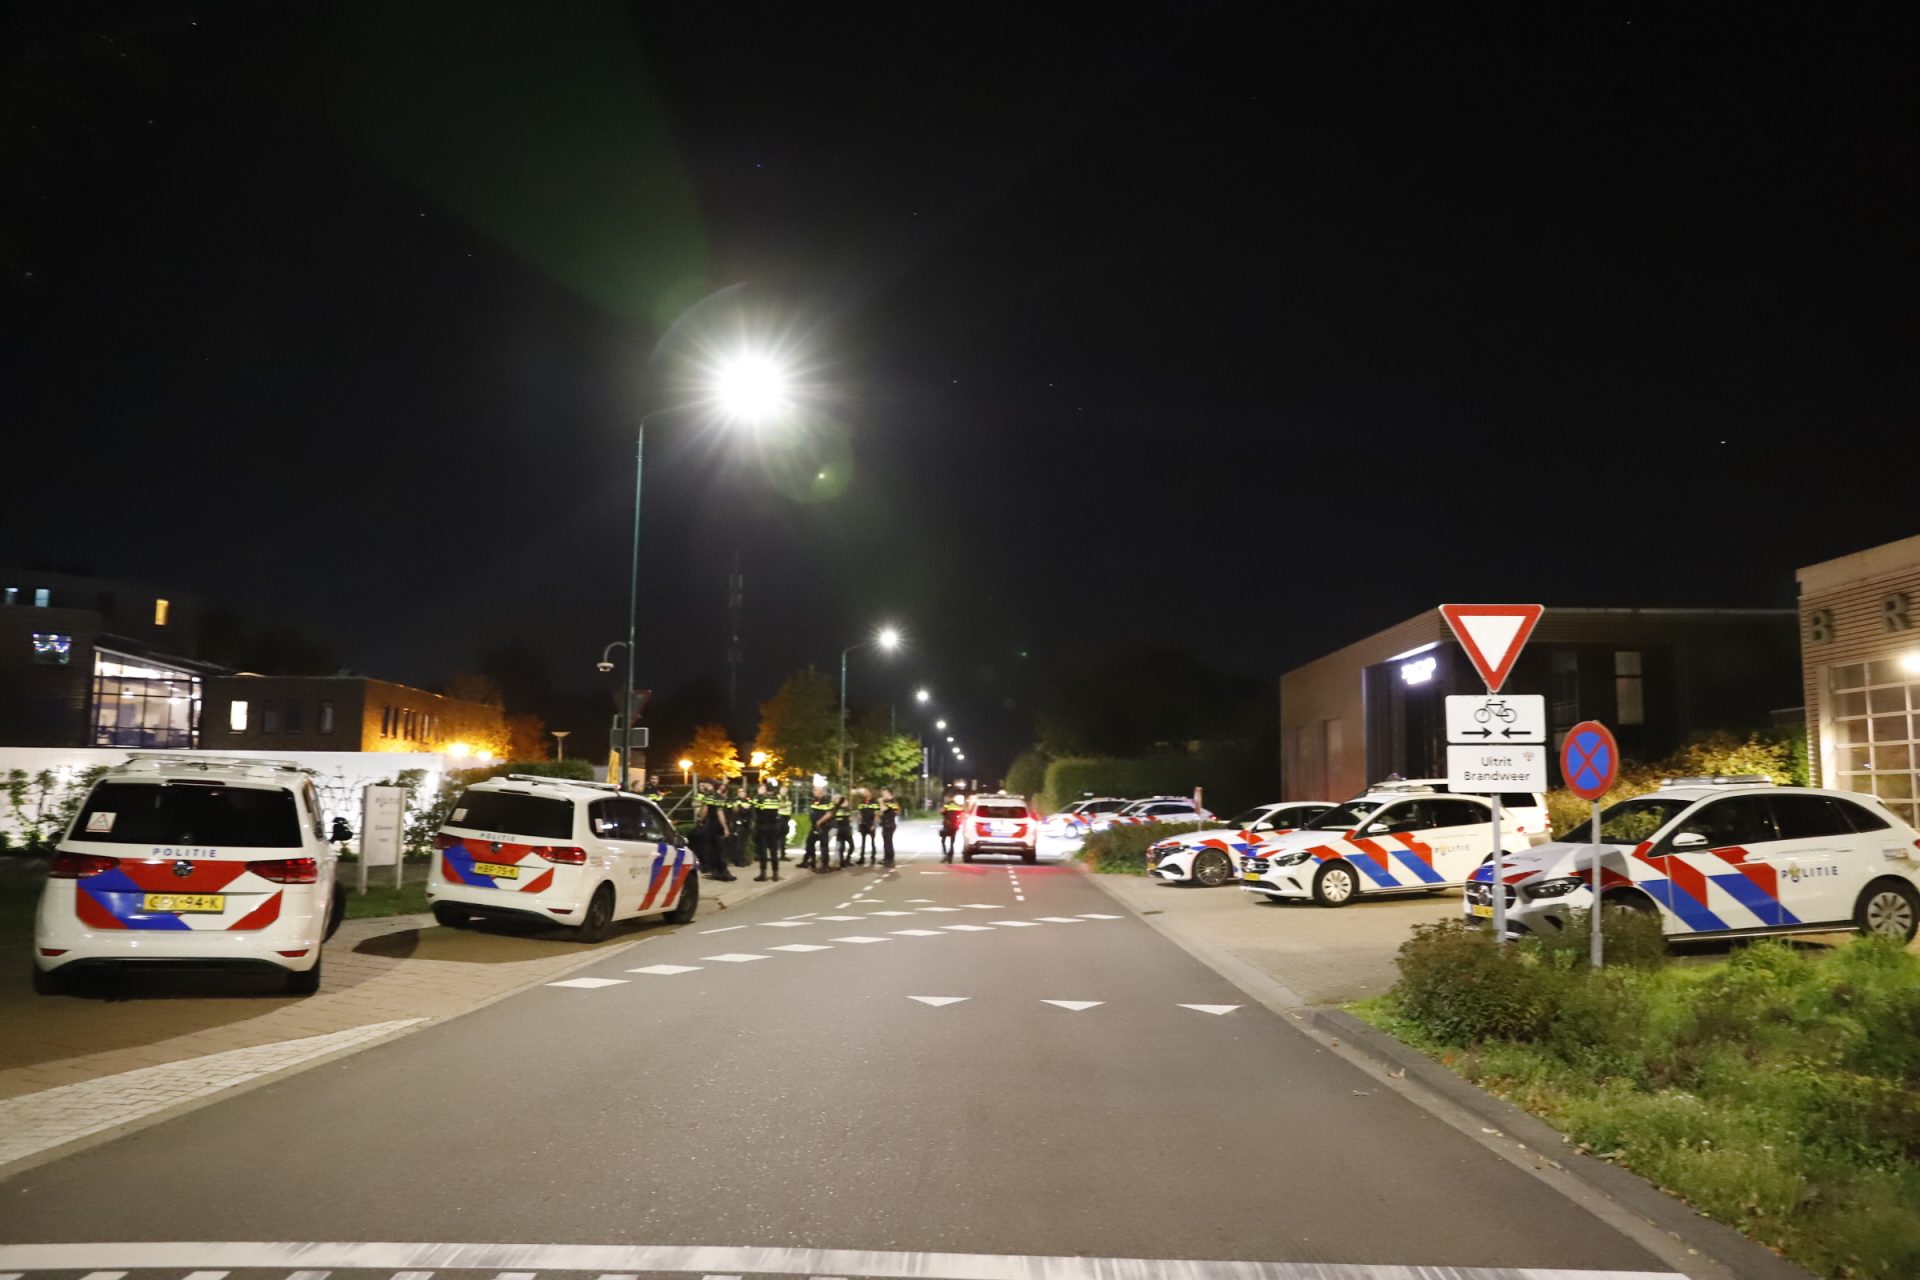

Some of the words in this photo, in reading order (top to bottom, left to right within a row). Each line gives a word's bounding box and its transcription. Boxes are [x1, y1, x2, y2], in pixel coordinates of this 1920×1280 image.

[1480, 757, 1512, 767] Uitrit
[1464, 771, 1531, 781] Brandweer
[480, 831, 516, 842] POLITIE
[152, 848, 217, 858] POLITIE
[1781, 865, 1839, 883] POLITIE
